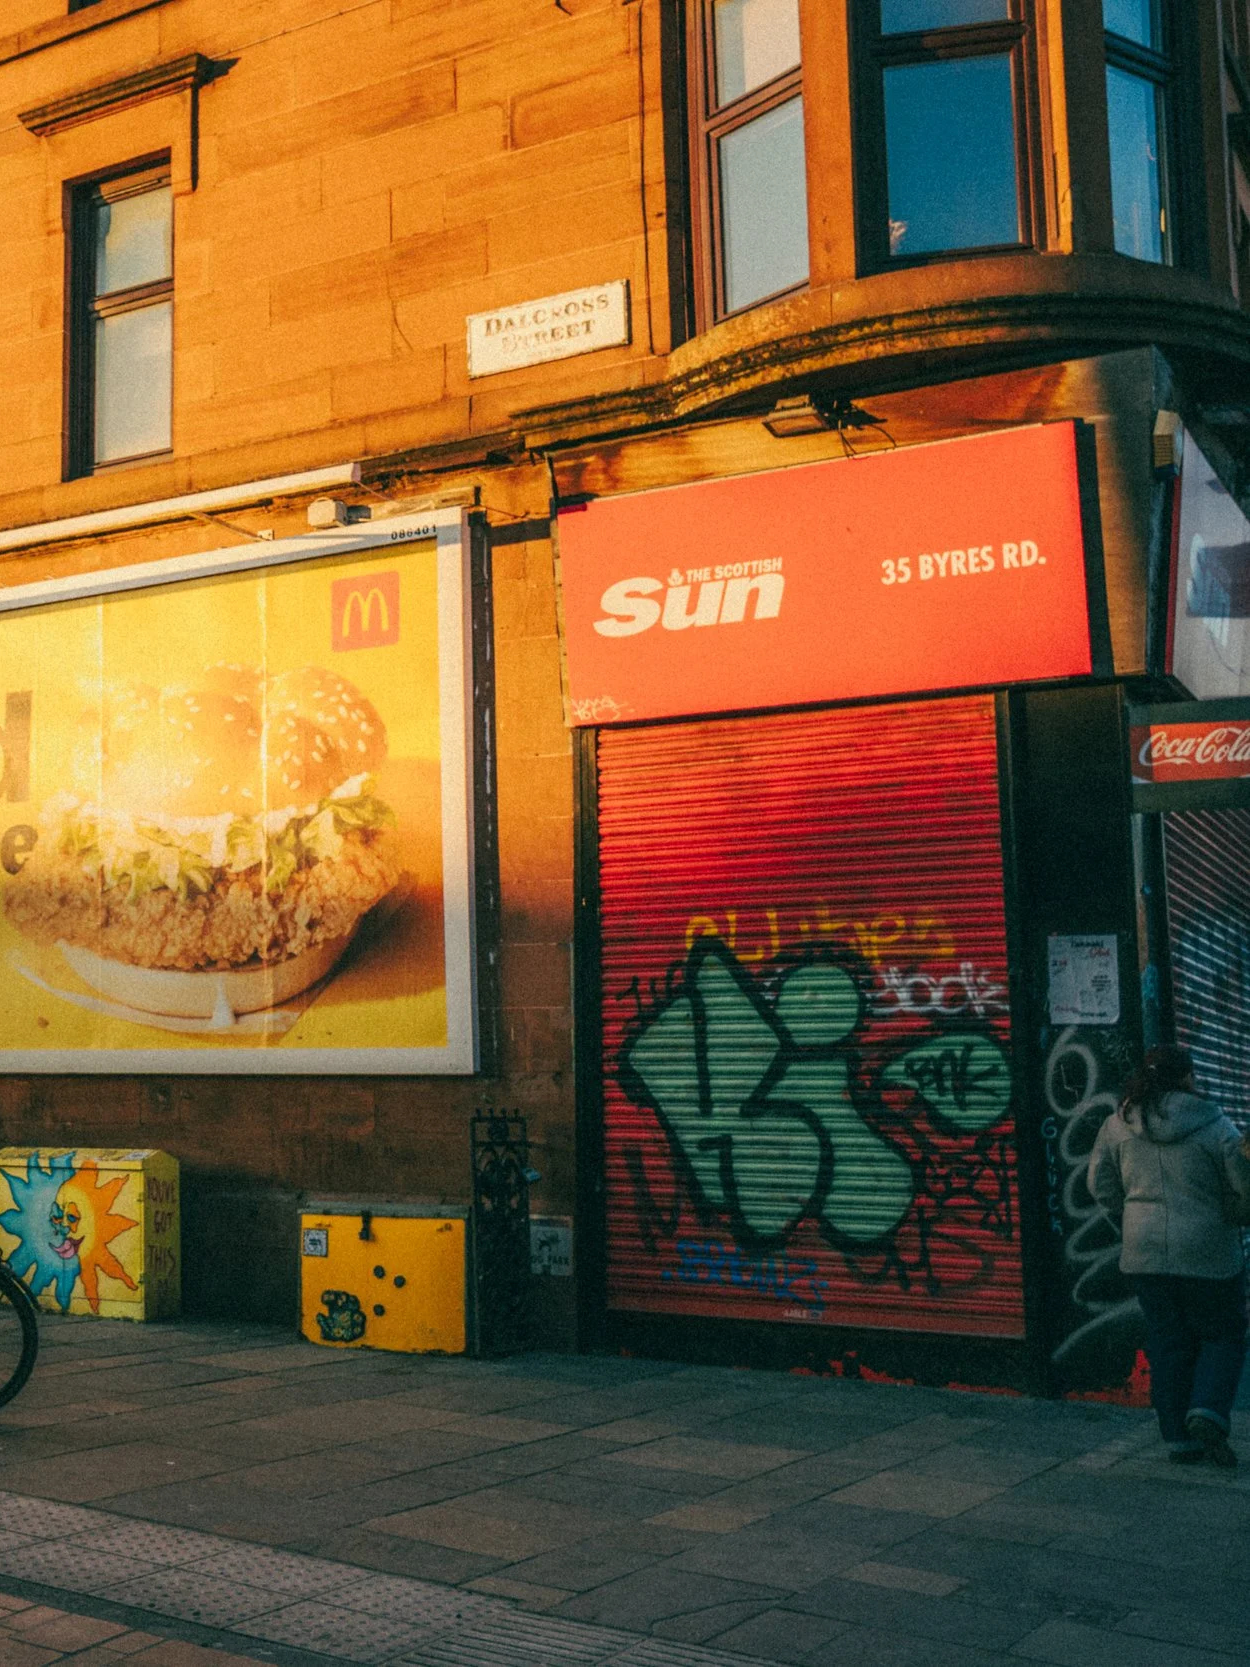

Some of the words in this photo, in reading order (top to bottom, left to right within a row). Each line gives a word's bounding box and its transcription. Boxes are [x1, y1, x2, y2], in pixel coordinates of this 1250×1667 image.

[501, 319, 596, 354] STREET
[686, 566, 711, 584] THE
[714, 556, 783, 580] SCOTTISH
[880, 556, 912, 586] 35
[918, 545, 995, 581] BYRES
[1002, 540, 1047, 570] RD.
[592, 572, 786, 639] Sun
[148, 1243, 177, 1279] THIS
